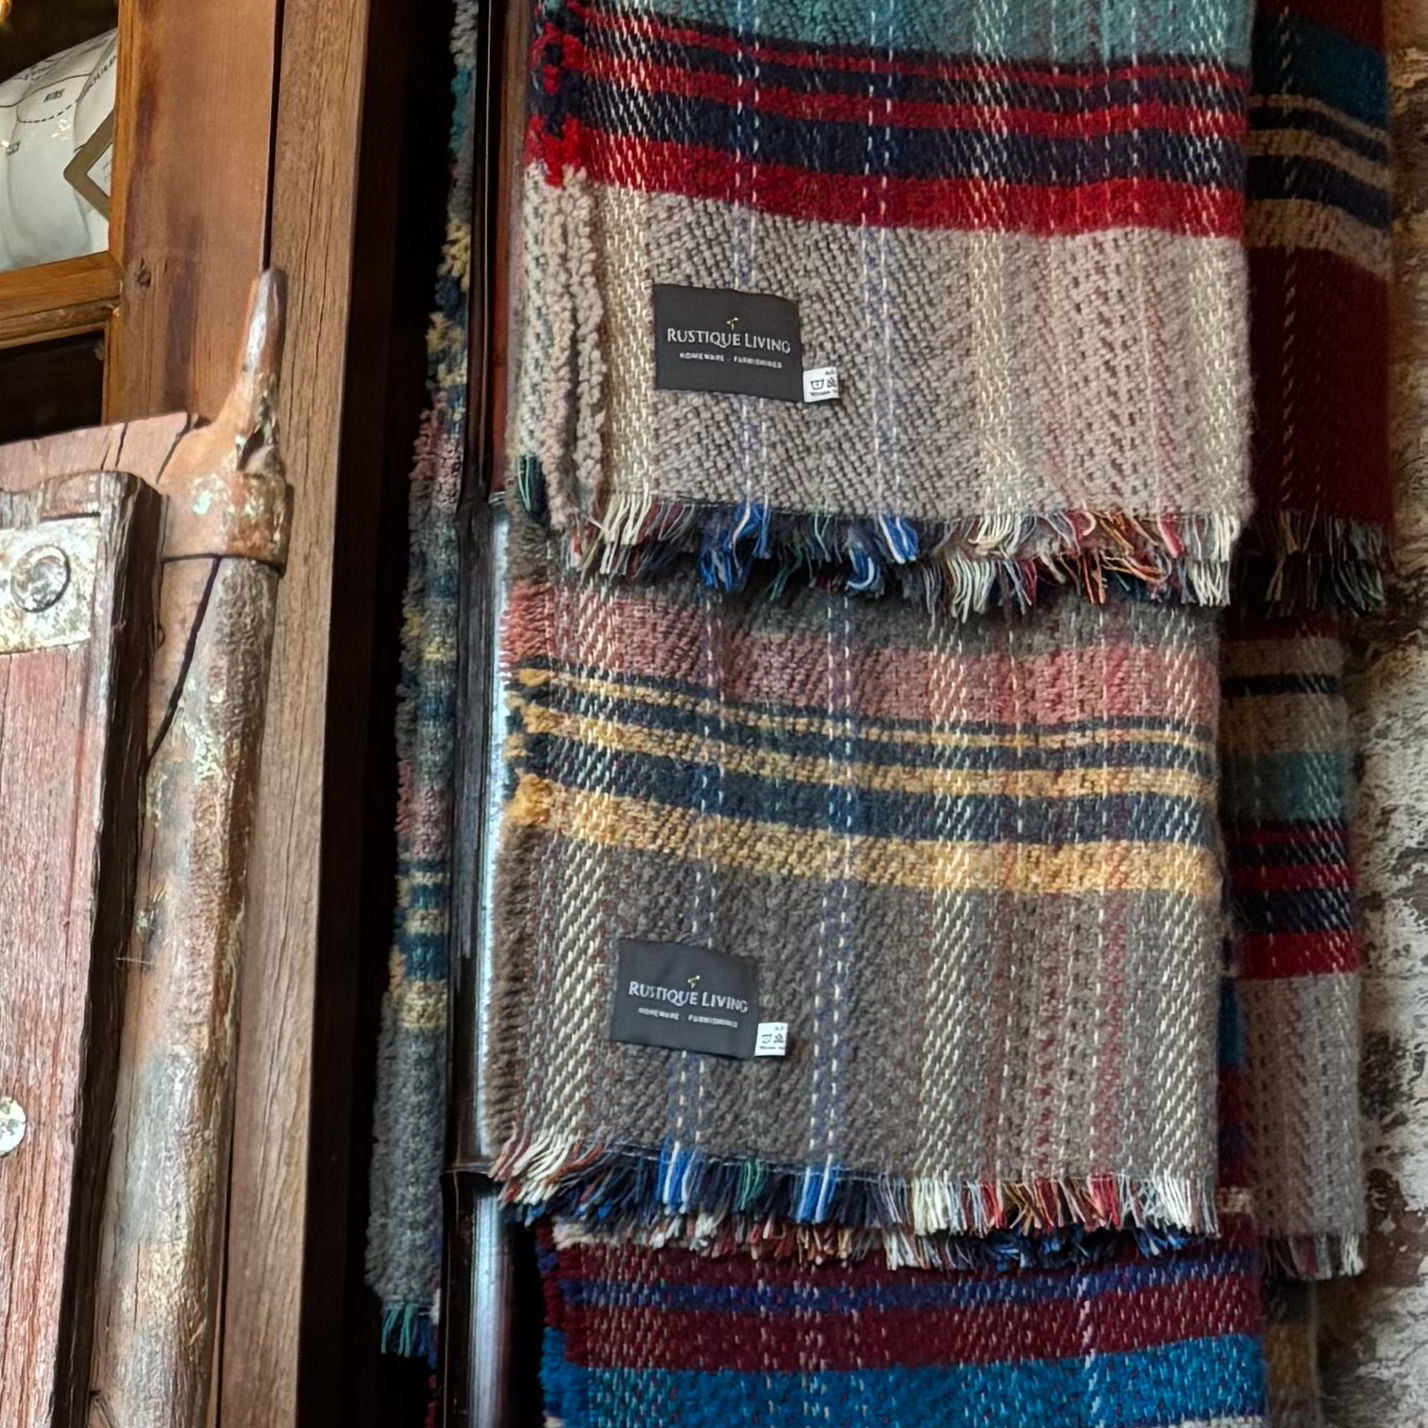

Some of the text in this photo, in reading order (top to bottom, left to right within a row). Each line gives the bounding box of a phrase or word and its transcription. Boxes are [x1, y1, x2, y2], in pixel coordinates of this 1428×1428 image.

[666, 327, 791, 353] RUSTIQUE LIVING
[628, 981, 748, 1013] RUSTIQUE LIVING
